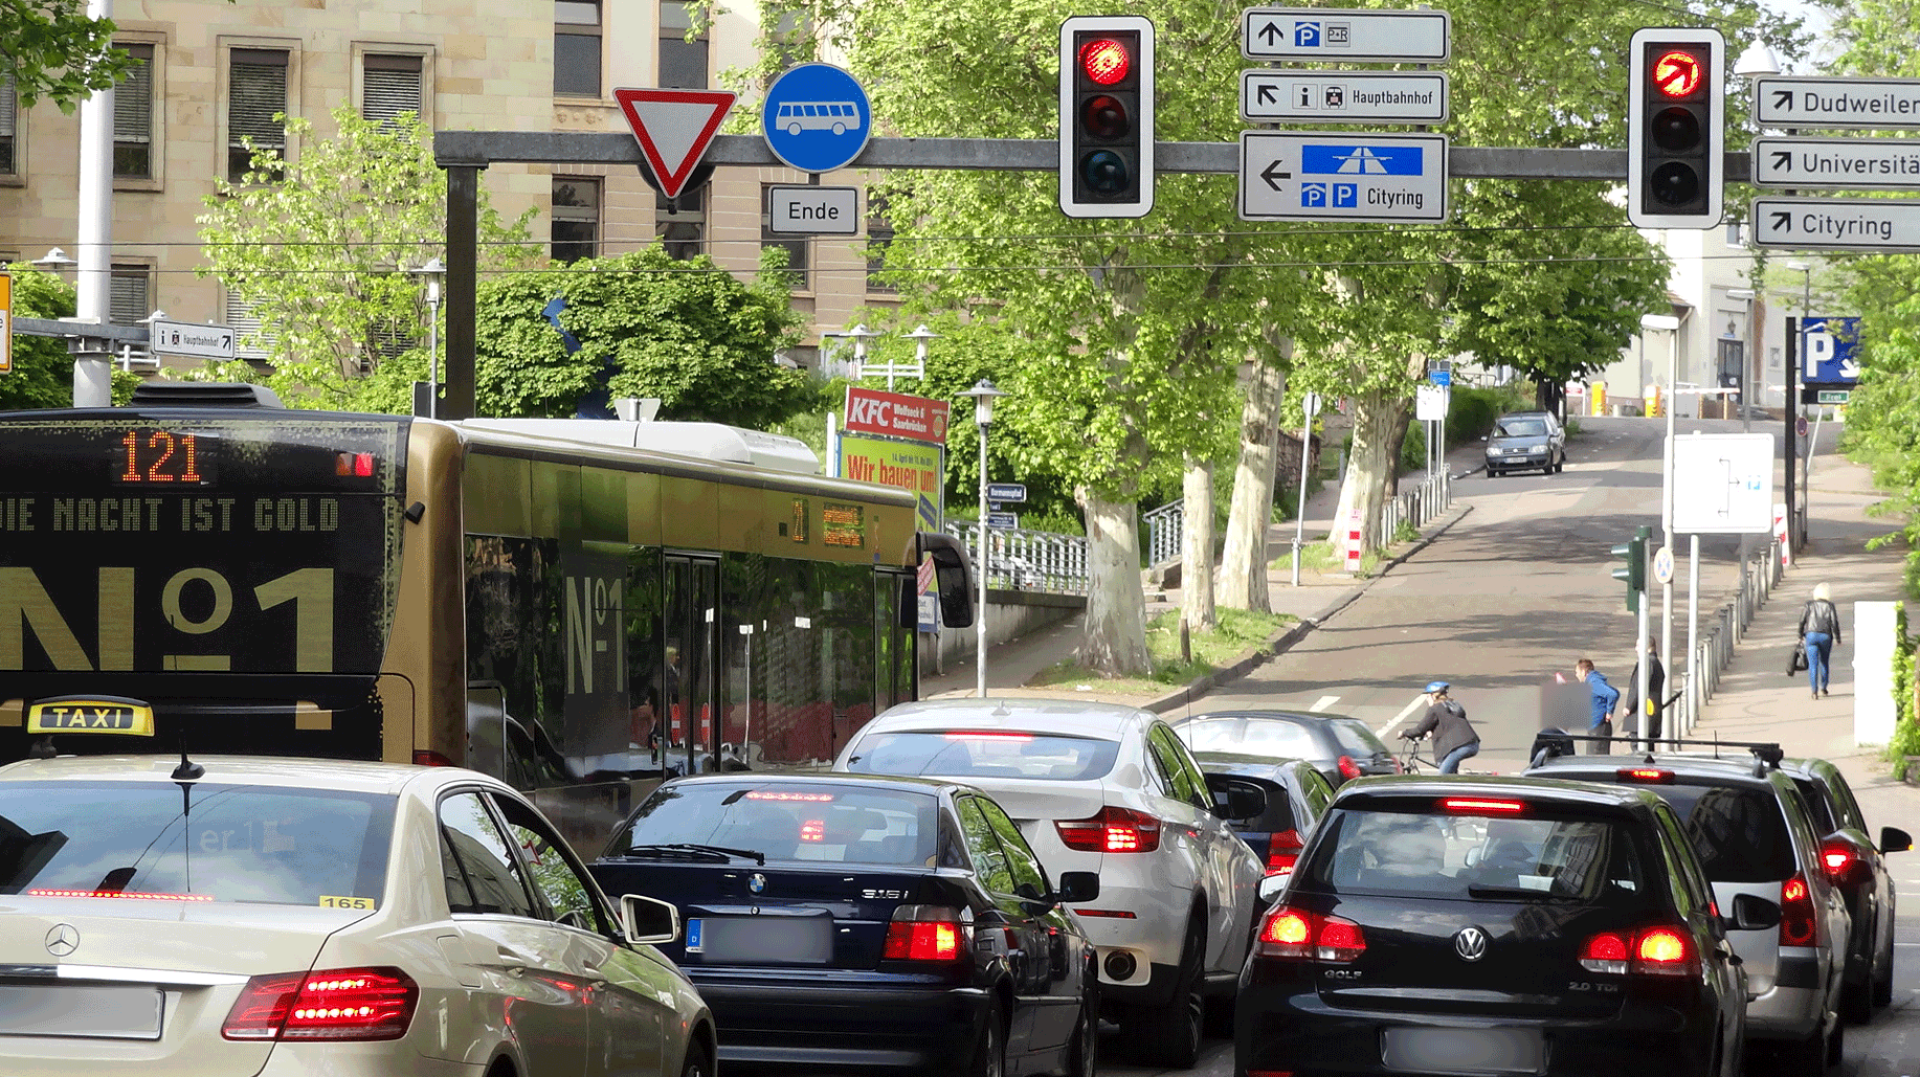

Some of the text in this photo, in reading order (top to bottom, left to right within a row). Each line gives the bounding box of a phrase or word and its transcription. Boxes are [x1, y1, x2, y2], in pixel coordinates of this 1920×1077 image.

[1353, 89, 1433, 107] Hauptbahnhof
[1367, 187, 1423, 210] Cityring
[789, 202, 839, 220] Ende
[1803, 214, 1892, 240] Cityring
[849, 396, 891, 427] KFC
[121, 431, 200, 482] 121
[847, 454, 875, 482] Wir
[879, 457, 917, 491] bauen
[0, 498, 338, 531] IE NACHT IST GOLD
[53, 708, 121, 728] TAXI
[324, 897, 367, 910] 165
[1324, 969, 1362, 980] GOLF
